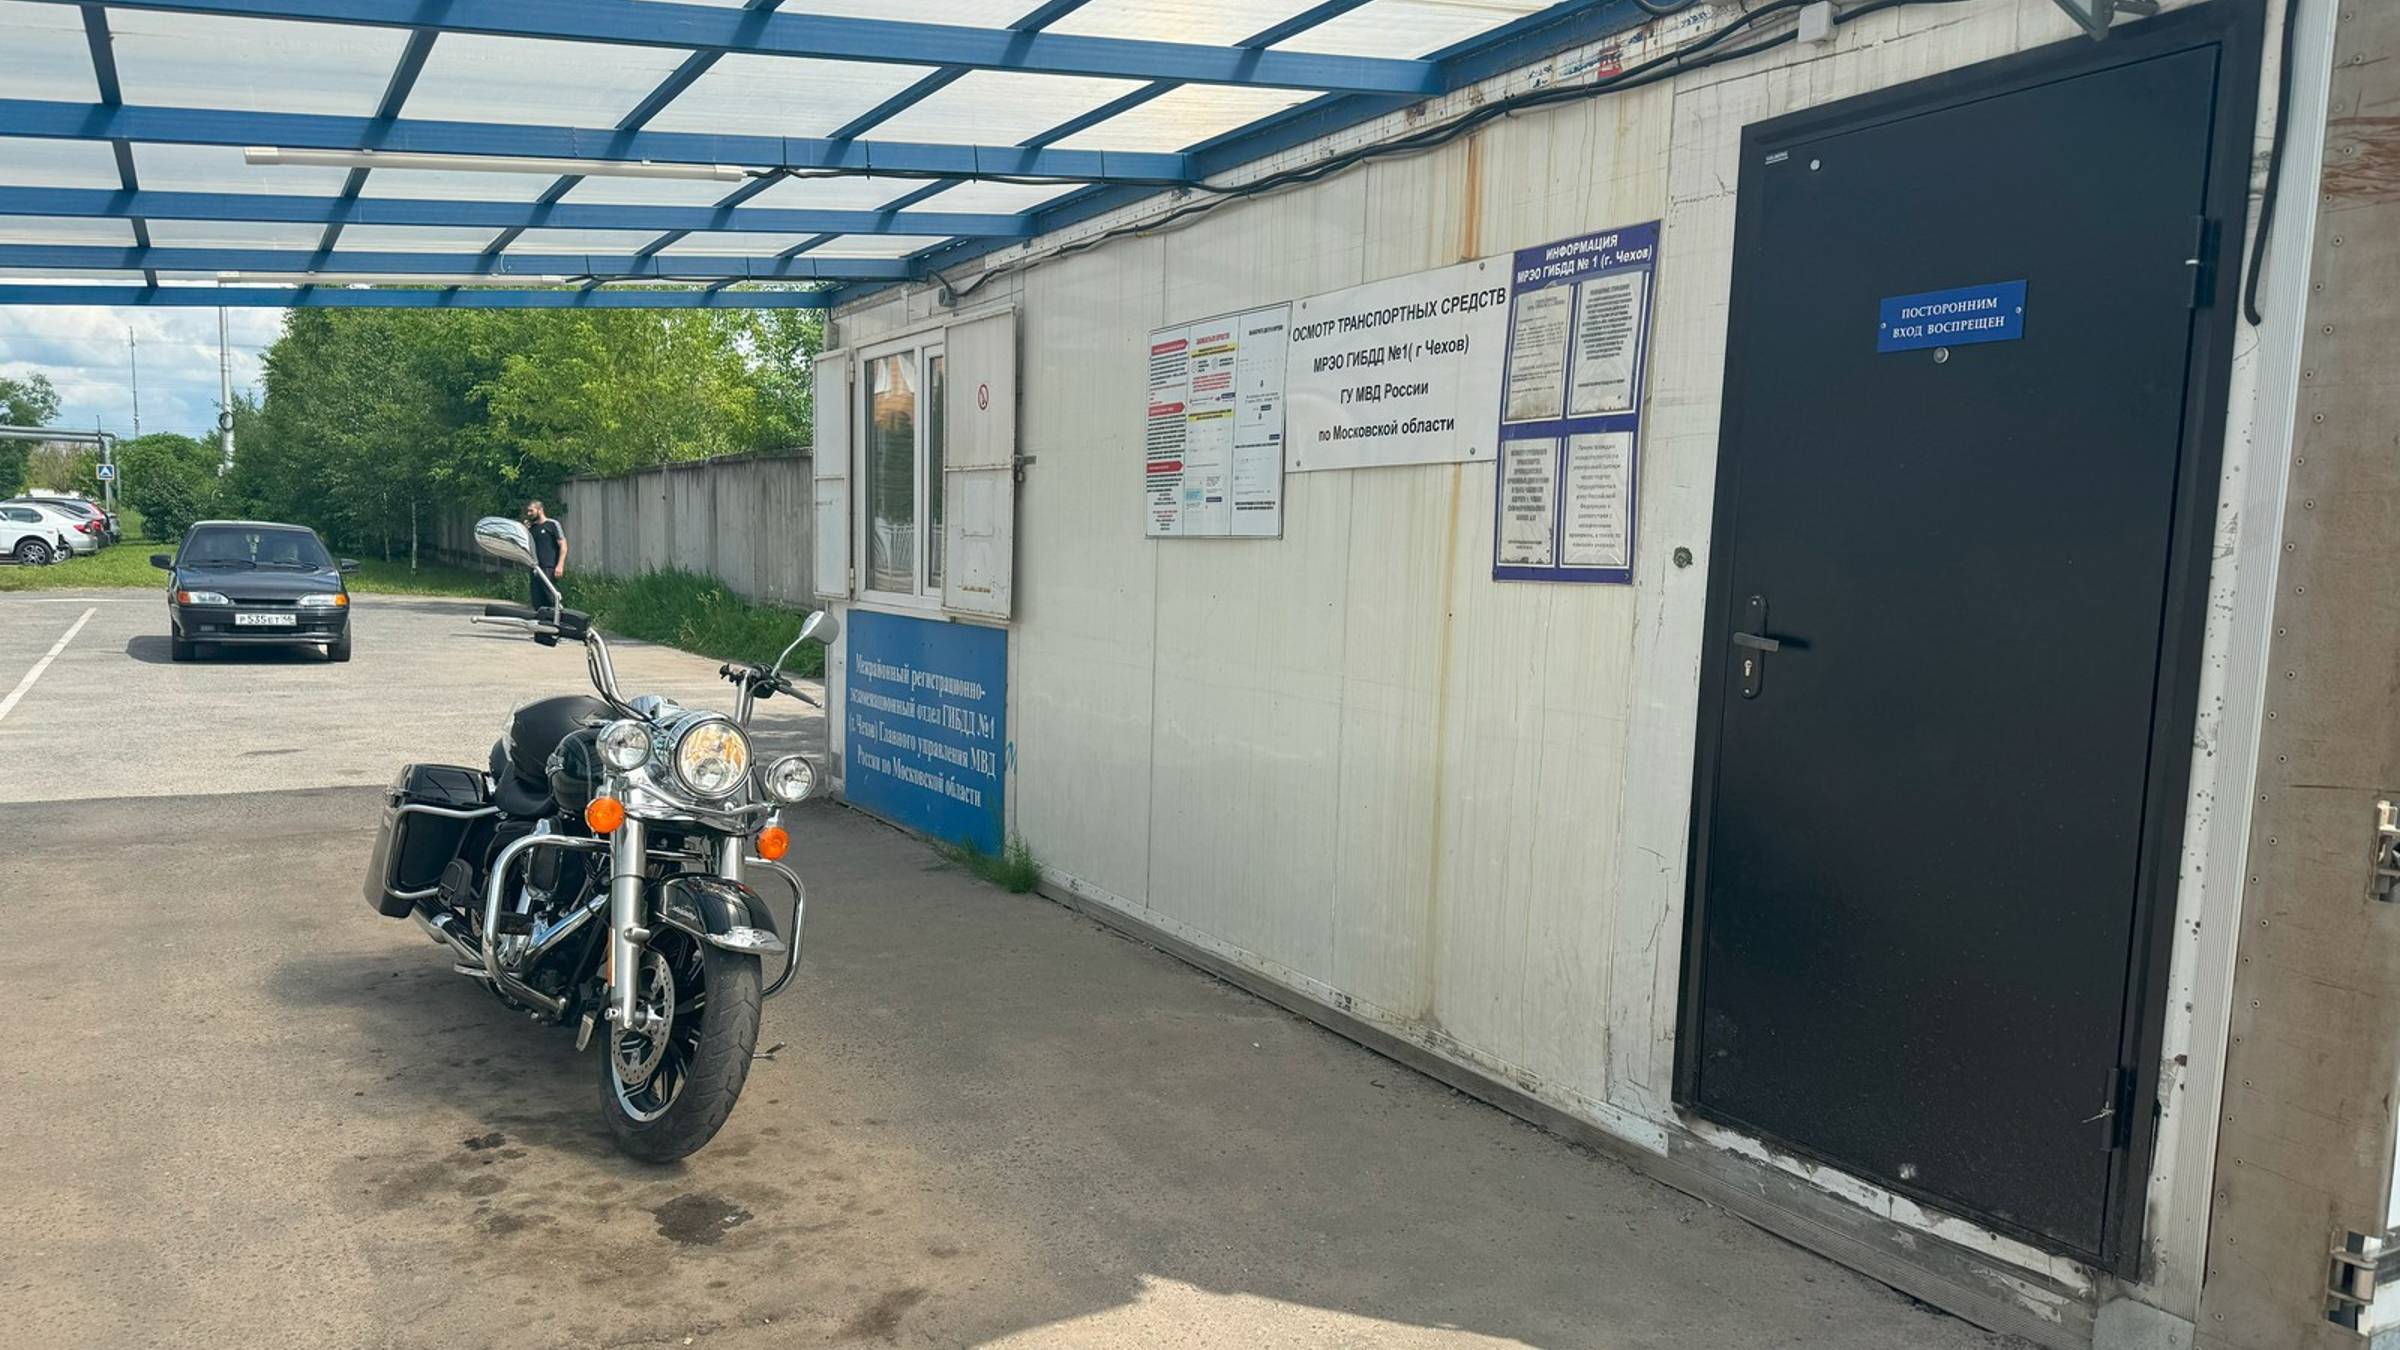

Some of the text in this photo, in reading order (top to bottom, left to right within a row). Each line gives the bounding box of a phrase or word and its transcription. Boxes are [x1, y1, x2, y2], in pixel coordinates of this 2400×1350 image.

[1545, 234, 1618, 260] ИНФОРМАЦИЯ
[1517, 268, 1540, 283] МРЭО
[1543, 260, 1575, 278] ГИБДД
[1577, 258, 1589, 271] №
[1593, 255, 1598, 268] 1
[1292, 319, 1336, 342] ОСМОТР
[1337, 300, 1437, 334] ТРАНСПОРТНЫХ
[1441, 287, 1506, 315] СРЕДСТВ
[1901, 297, 1998, 320] ПОСТОРОННИМ
[1892, 316, 2006, 338] ВХОД ВОСПРЕЩЕН
[1313, 356, 1343, 373] МРЭО
[1346, 348, 1384, 367] ГИБДД
[1425, 334, 1470, 356] Чехов)
[1340, 382, 1429, 404] ГУ МВД России
[1318, 417, 1455, 442] по Московской области
[911, 669, 986, 701] регистрационно-
[917, 704, 941, 725] отдел
[942, 704, 975, 737] ГИБДД
[879, 720, 916, 751] Главного
[917, 736, 969, 769] управления
[970, 746, 997, 782] МВД
[892, 755, 944, 794] Московской
[944, 775, 981, 808] области
